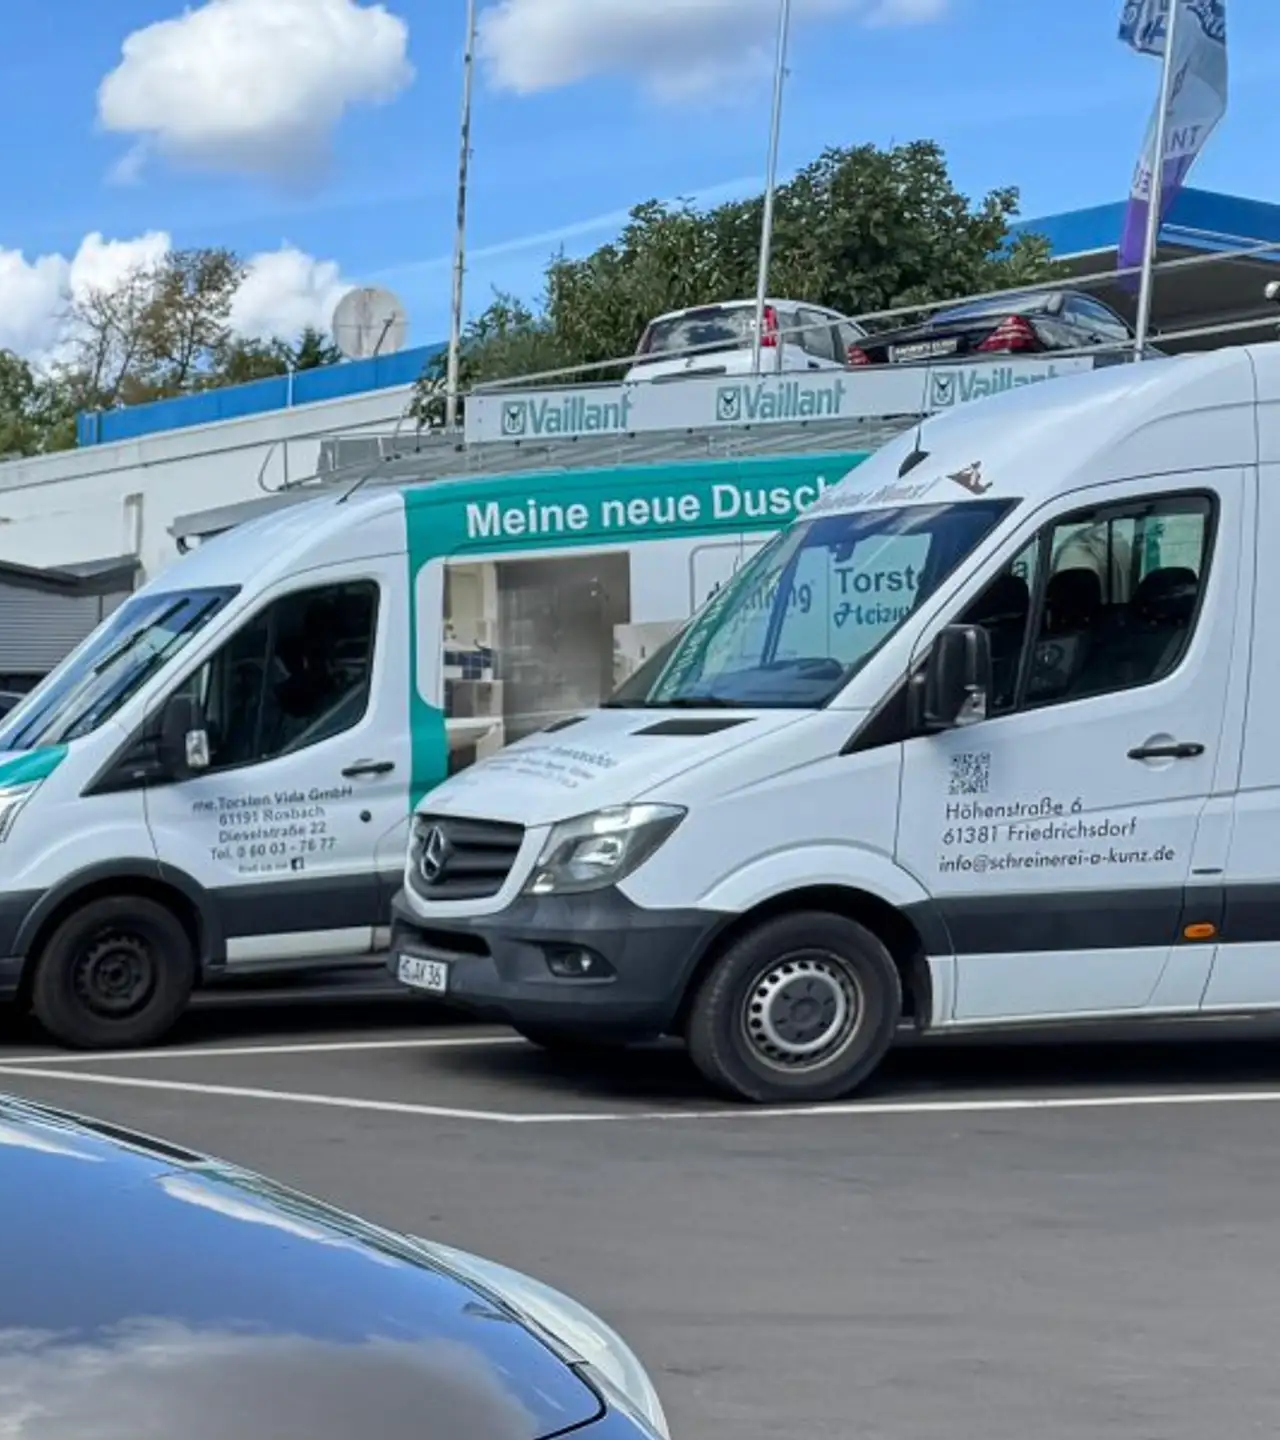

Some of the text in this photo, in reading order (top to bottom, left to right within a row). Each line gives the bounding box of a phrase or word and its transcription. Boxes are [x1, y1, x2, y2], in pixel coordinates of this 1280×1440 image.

[527, 391, 632, 434] Vaillant
[743, 379, 846, 419] Vaillant
[466, 499, 588, 538] Meine
[602, 494, 701, 529] neue
[308, 785, 353, 801] GmbH
[945, 796, 1083, 821] Höhenstraße 6
[942, 816, 1137, 846] 61381 Friedrichsdorf
